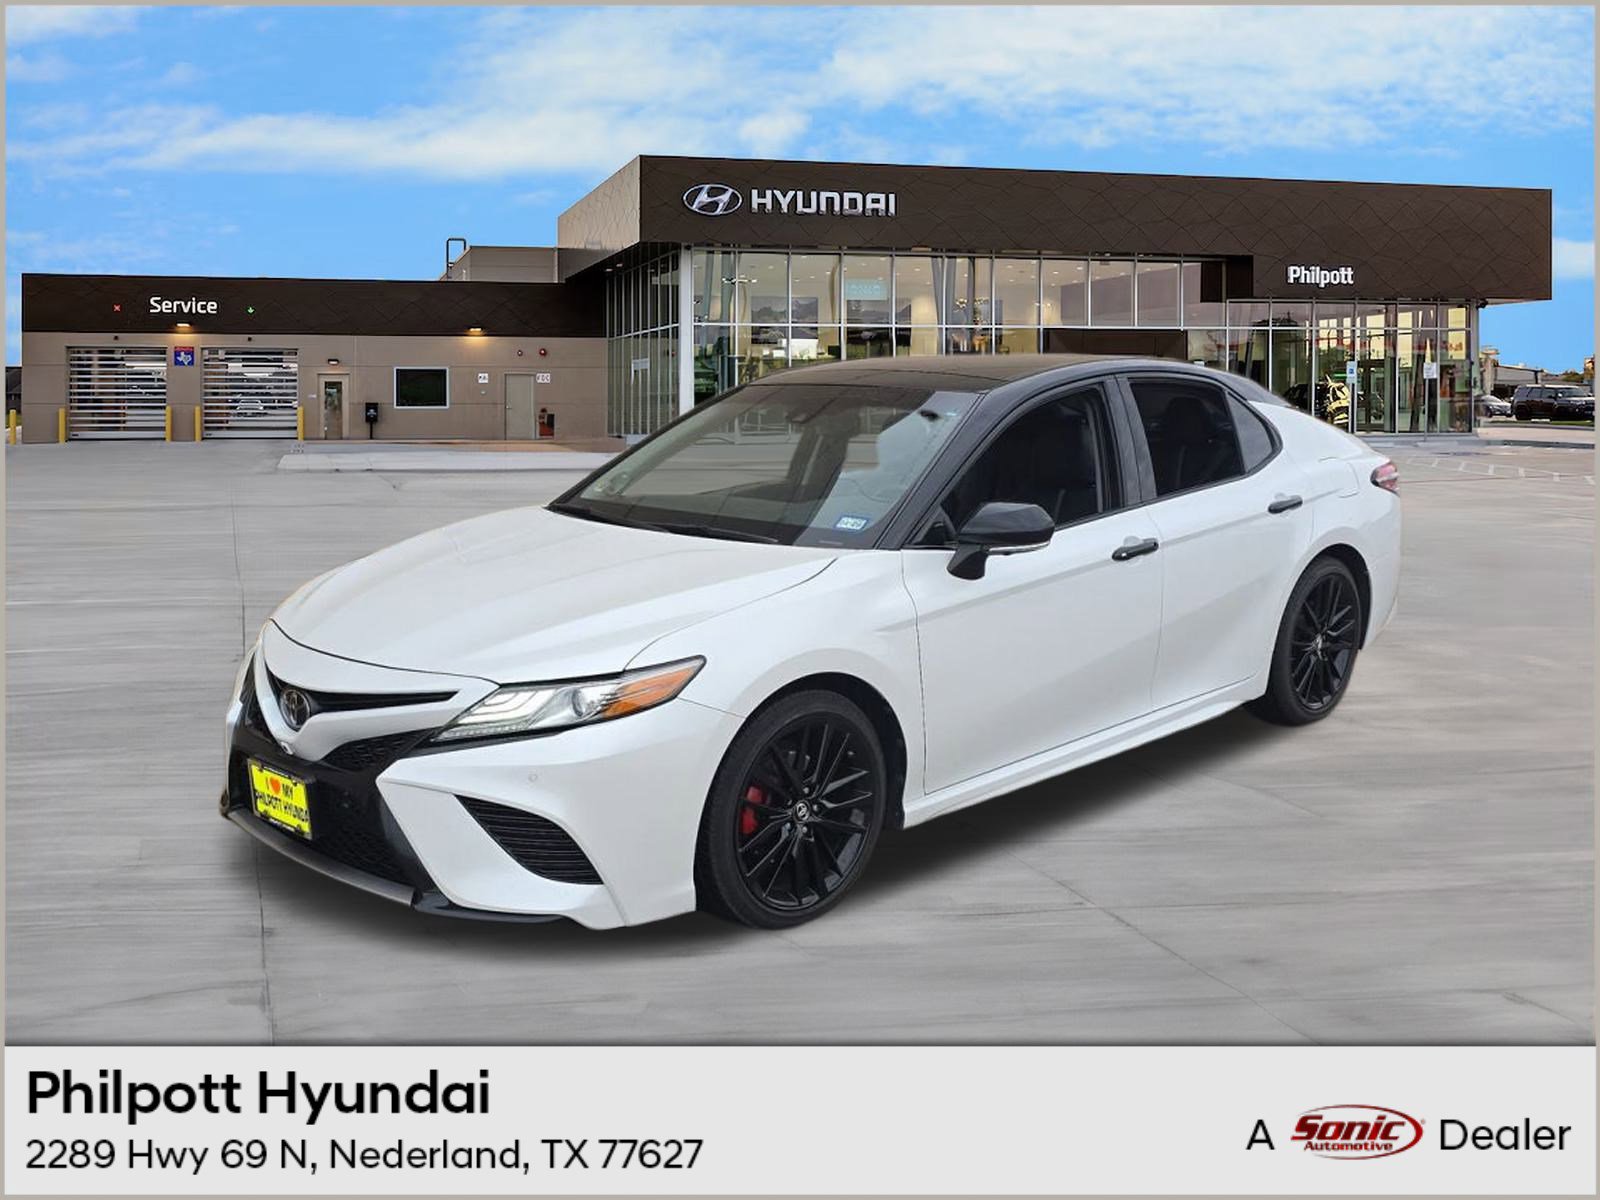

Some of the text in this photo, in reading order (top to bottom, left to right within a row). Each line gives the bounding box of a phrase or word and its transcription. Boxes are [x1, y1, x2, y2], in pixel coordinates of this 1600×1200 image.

[750, 188, 897, 217] HYUNDAI
[1287, 265, 1355, 288] Philpott
[149, 297, 218, 314] Service
[282, 801, 310, 823] HYUNDA
